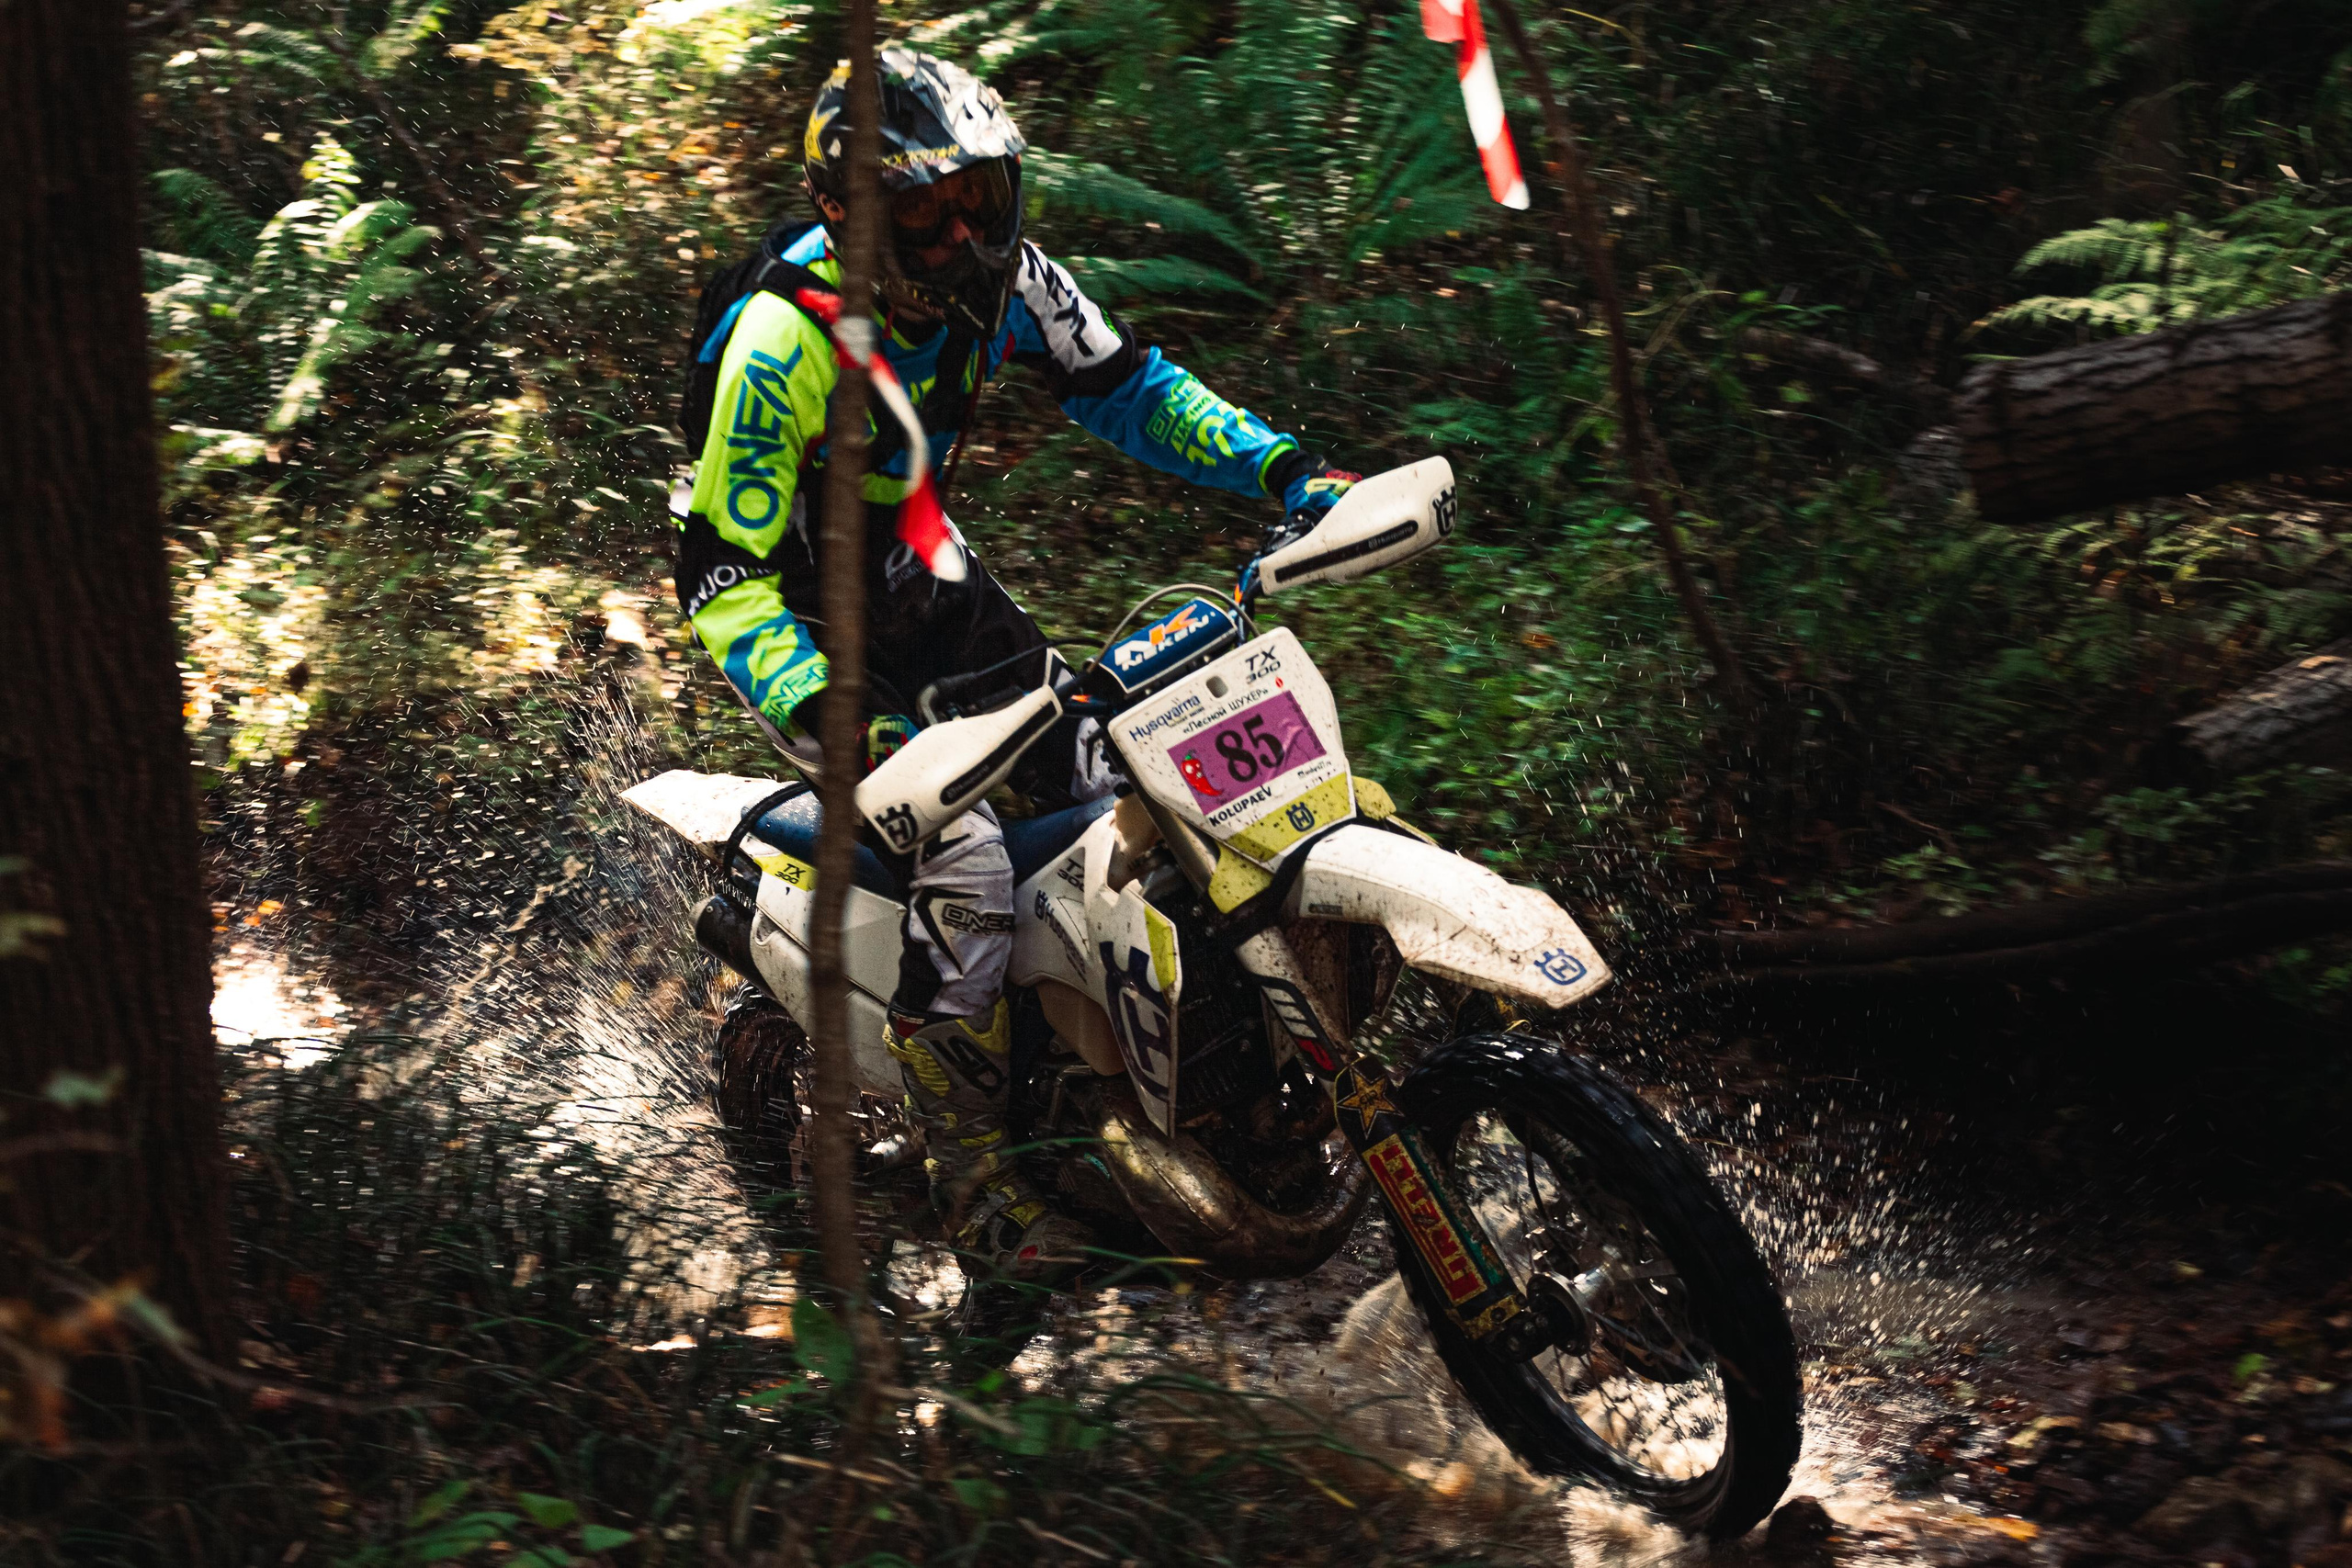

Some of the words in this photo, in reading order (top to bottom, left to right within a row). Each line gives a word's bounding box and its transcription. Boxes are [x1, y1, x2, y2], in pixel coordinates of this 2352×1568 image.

[1245, 645, 1277, 671] TX
[1246, 660, 1282, 685] 300
[1128, 694, 1202, 742] Husqvarna
[1215, 714, 1285, 782] 85
[1208, 784, 1273, 827] KOLUPAEV
[775, 871, 799, 885] 300
[783, 863, 807, 879] TX
